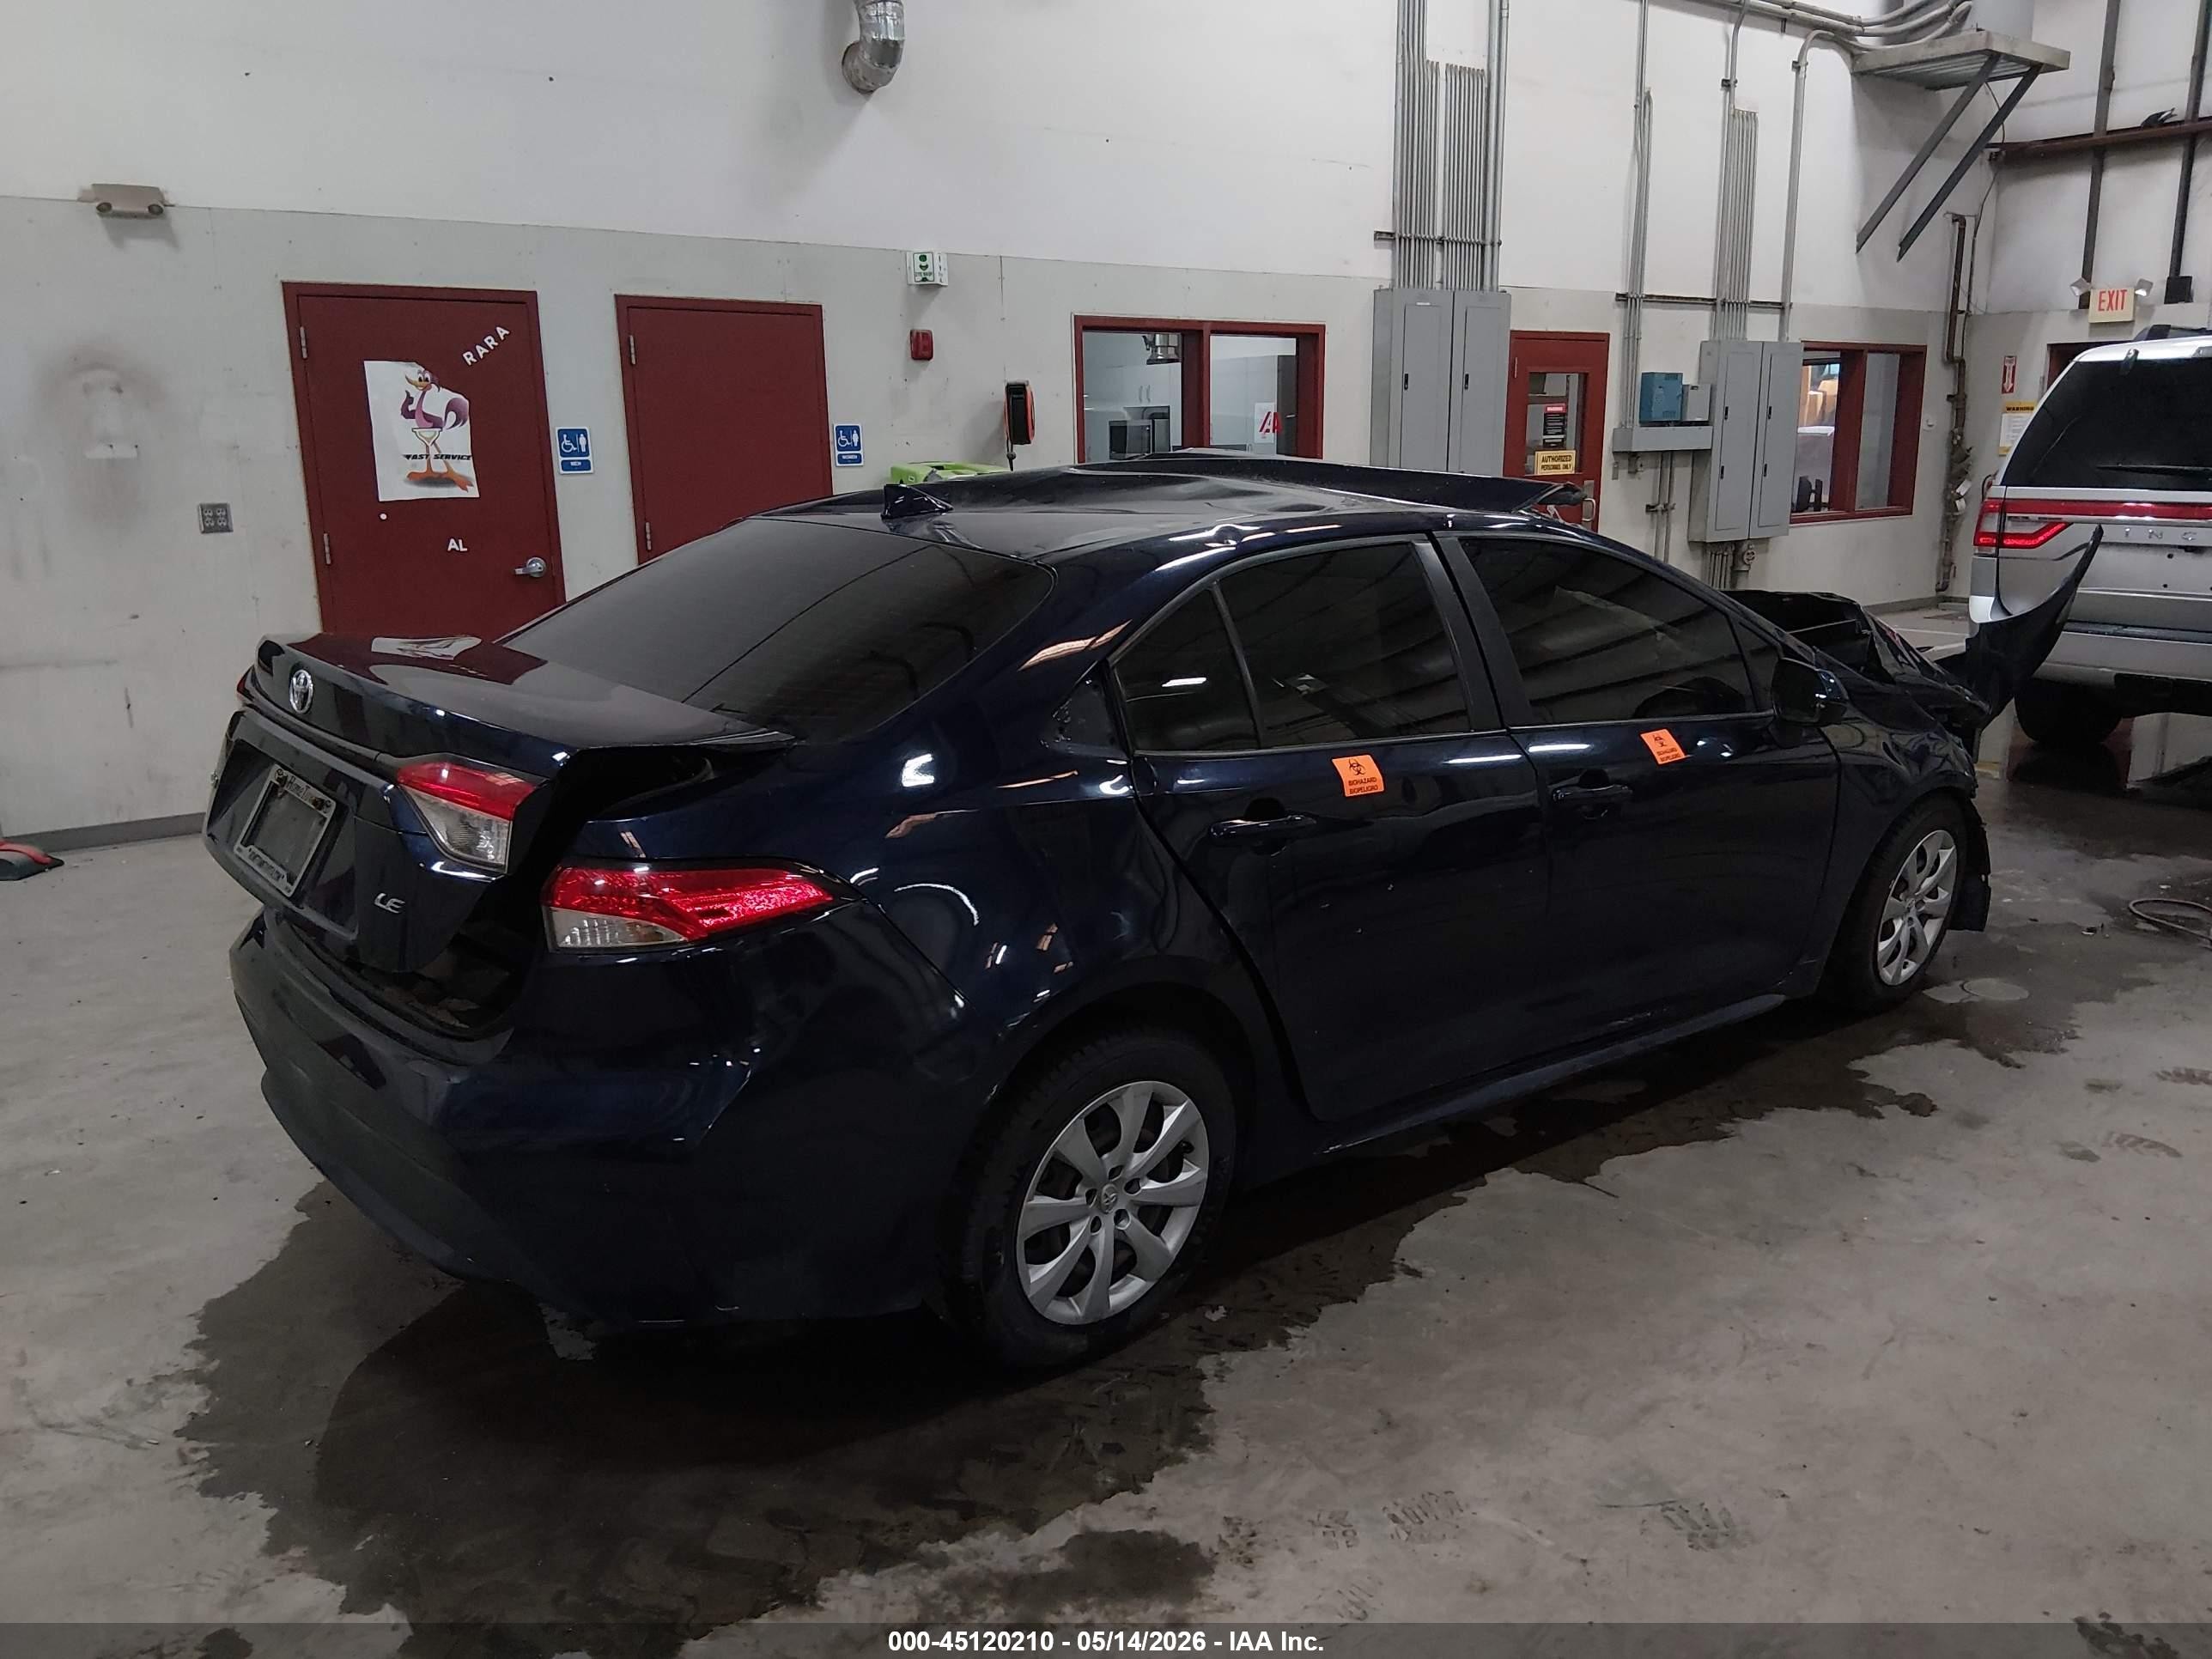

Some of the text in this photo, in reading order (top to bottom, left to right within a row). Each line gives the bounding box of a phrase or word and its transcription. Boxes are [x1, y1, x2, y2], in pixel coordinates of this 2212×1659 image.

[2098, 289, 2128, 312] EXIT
[462, 325, 510, 367] RARA
[1541, 454, 1572, 464] AUTHORIZED
[447, 538, 468, 552] AL
[1348, 776, 1377, 787] BIOHAZARD
[1349, 784, 1379, 794] BIOPELIGRO
[374, 892, 405, 914] LE
